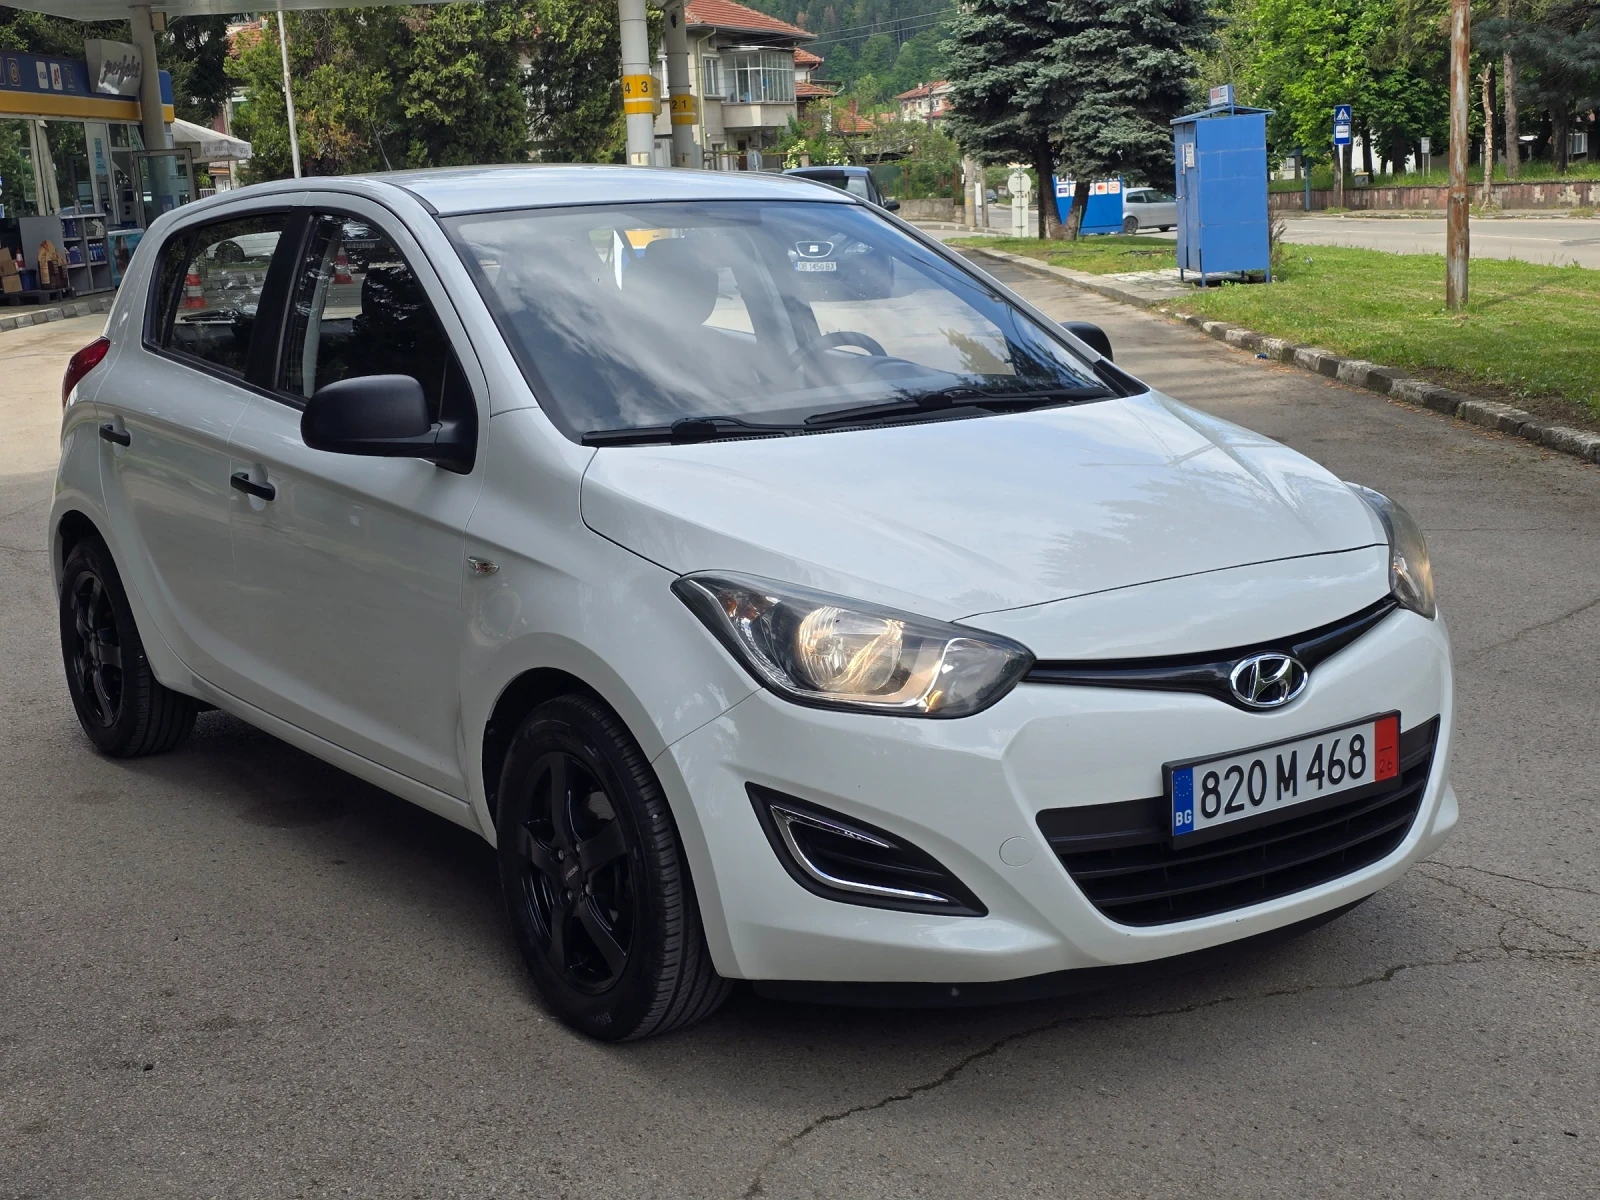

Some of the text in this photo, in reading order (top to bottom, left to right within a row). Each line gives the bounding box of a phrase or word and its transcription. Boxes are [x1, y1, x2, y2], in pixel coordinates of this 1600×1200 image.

[624, 81, 648, 94] 4 3
[671, 100, 687, 110] 2 1
[1379, 758, 1393, 774] 26
[1200, 733, 1367, 819] 820 M 468
[1175, 809, 1192, 827] BG
